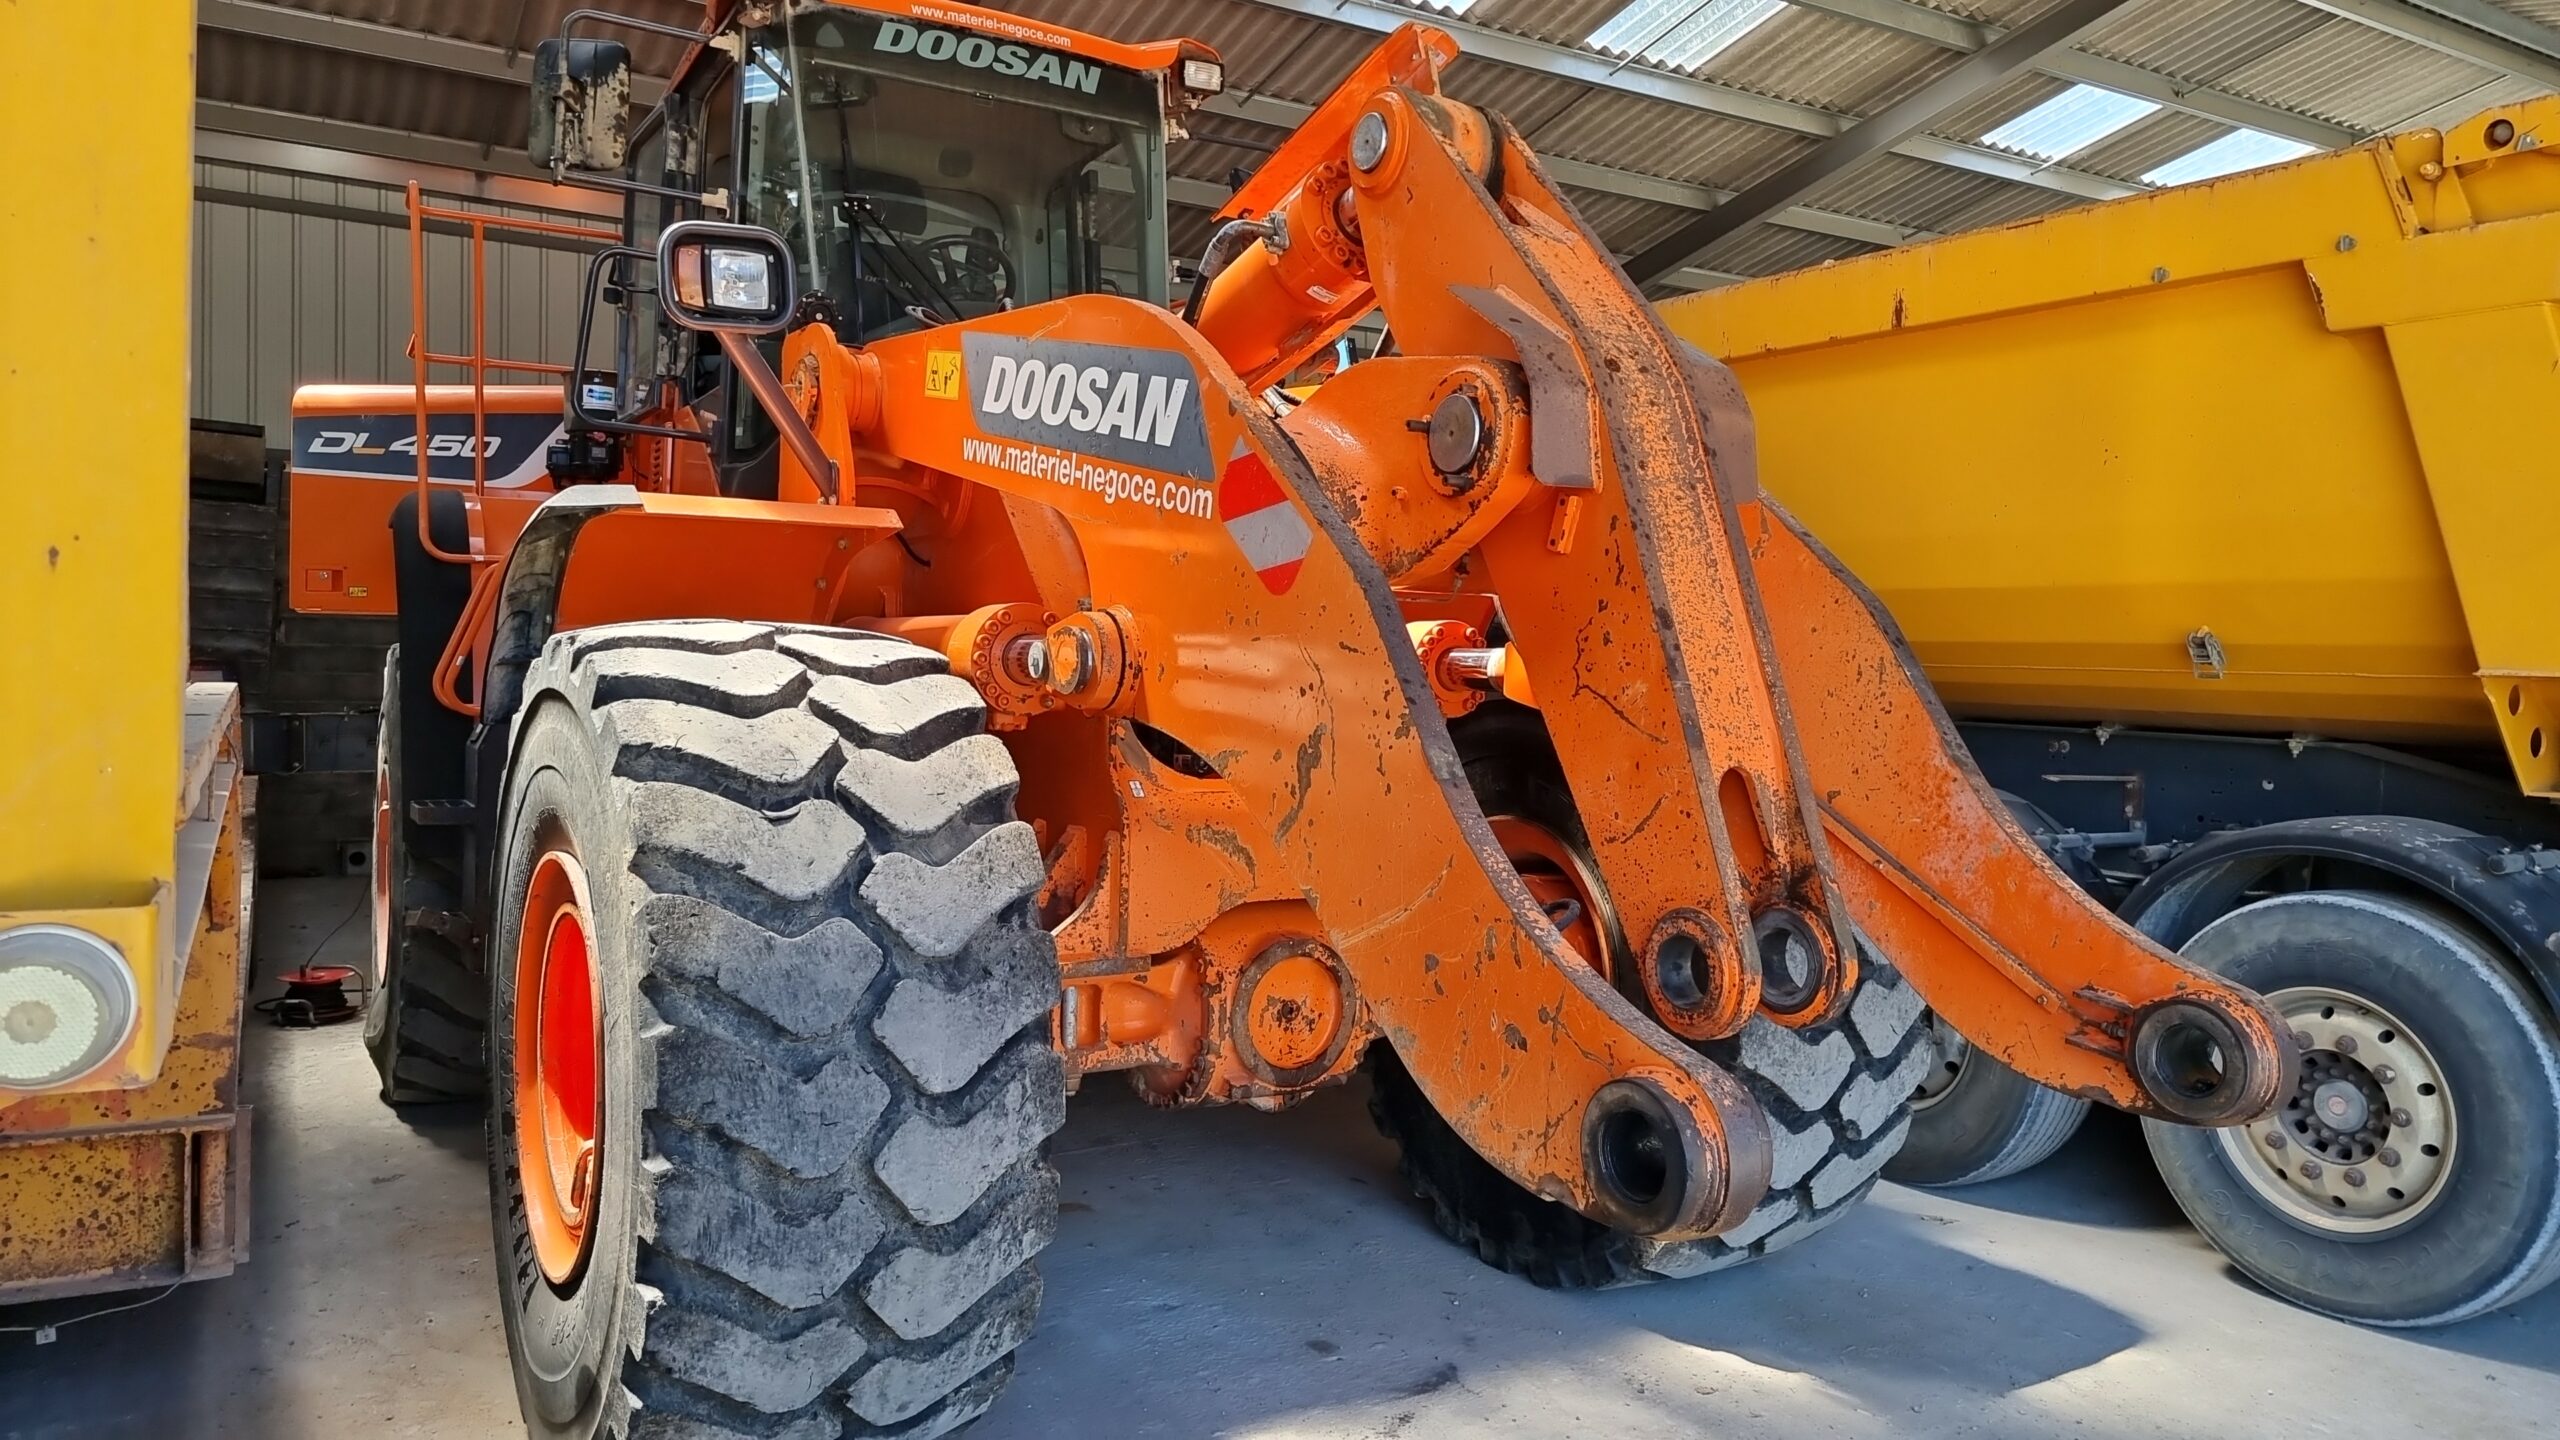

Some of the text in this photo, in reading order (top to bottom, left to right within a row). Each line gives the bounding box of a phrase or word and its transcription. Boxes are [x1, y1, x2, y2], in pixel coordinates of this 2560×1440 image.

[873, 21, 1102, 95] DOOSAN
[911, 4, 1071, 47] www.materiel-negoce.com
[982, 355, 1189, 447] DOOSAN
[963, 437, 1213, 519] www.materiel-negoce.com
